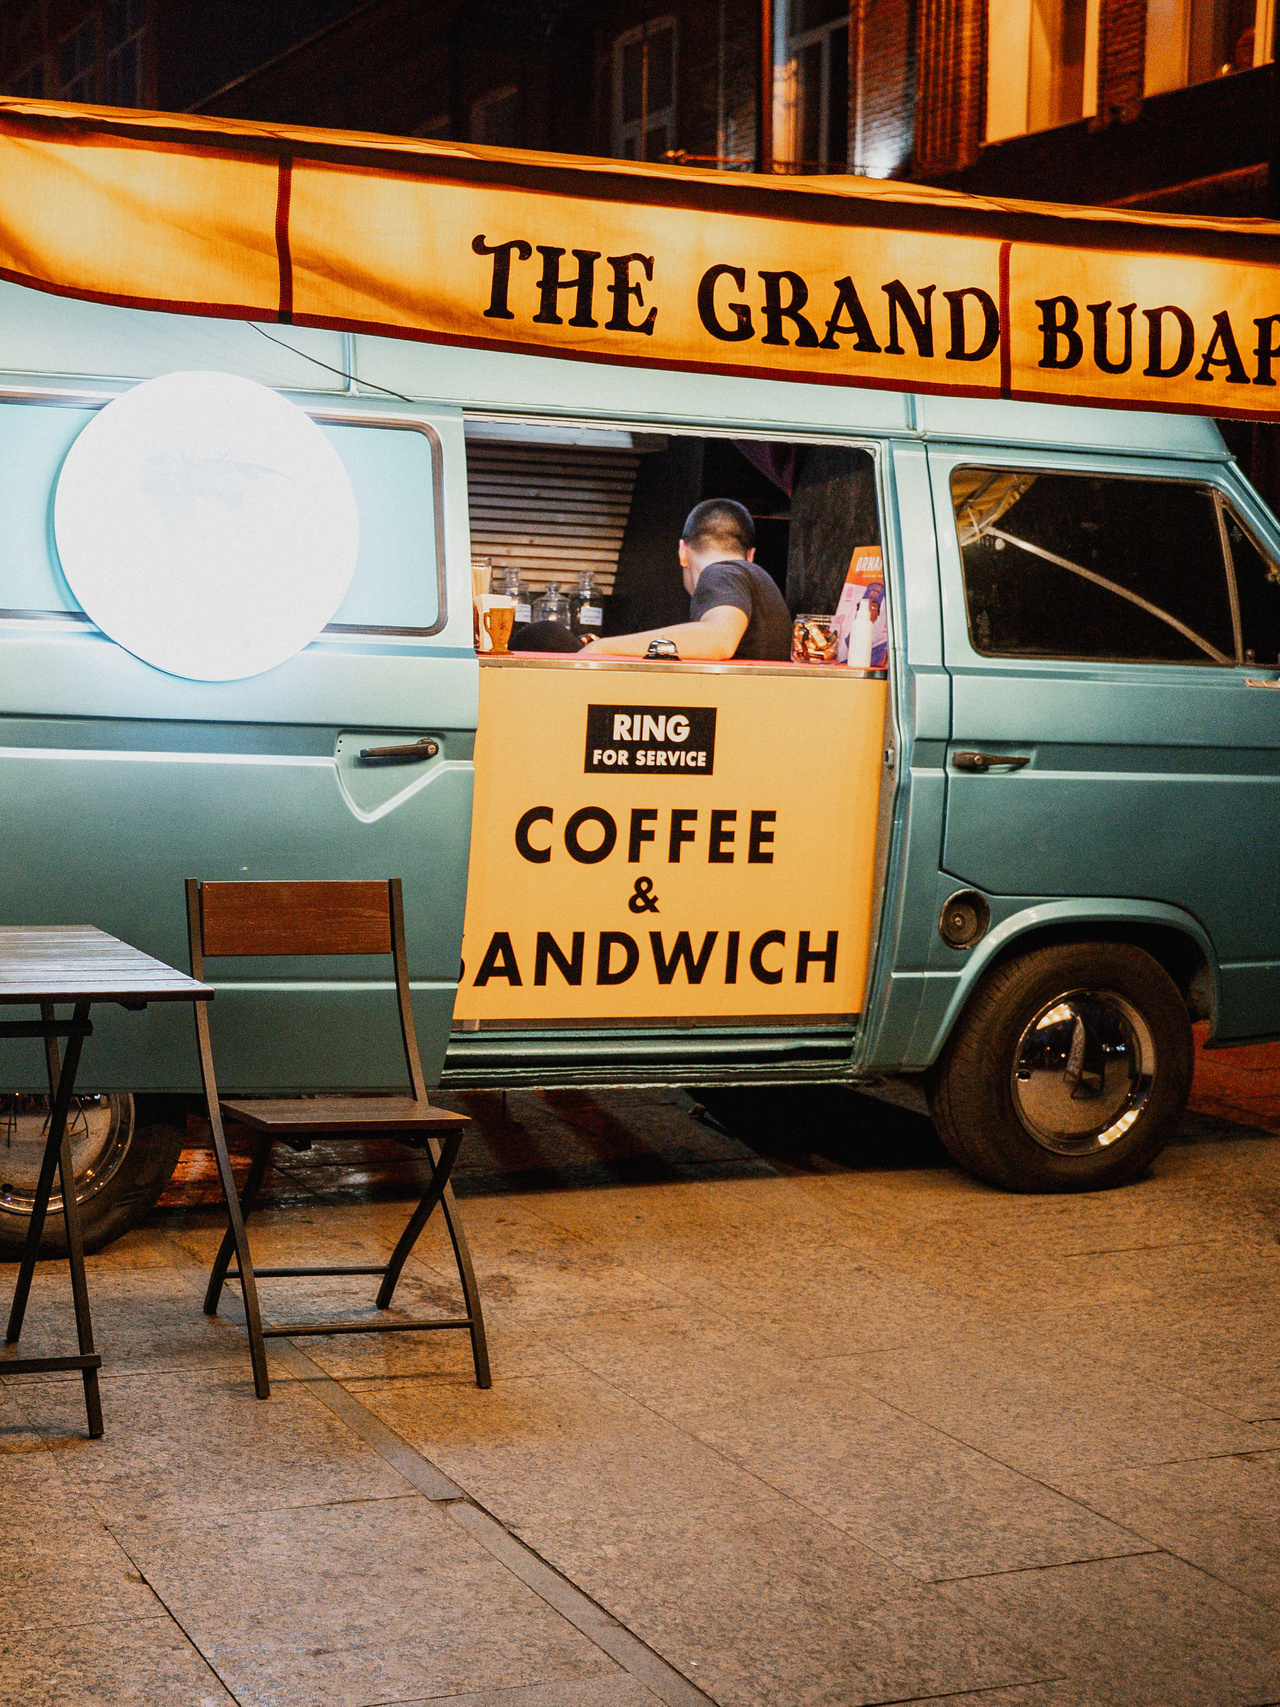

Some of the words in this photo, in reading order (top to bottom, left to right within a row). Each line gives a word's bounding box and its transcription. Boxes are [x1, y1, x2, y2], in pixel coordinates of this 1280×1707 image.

[472, 234, 657, 335] THE
[697, 262, 1002, 362] GRAND
[613, 714, 691, 742] RING
[592, 750, 628, 766] FOR
[635, 750, 707, 767] SERVICE
[515, 806, 777, 864] COFFEE
[628, 876, 660, 914] &
[458, 930, 839, 987] ANDWICH
